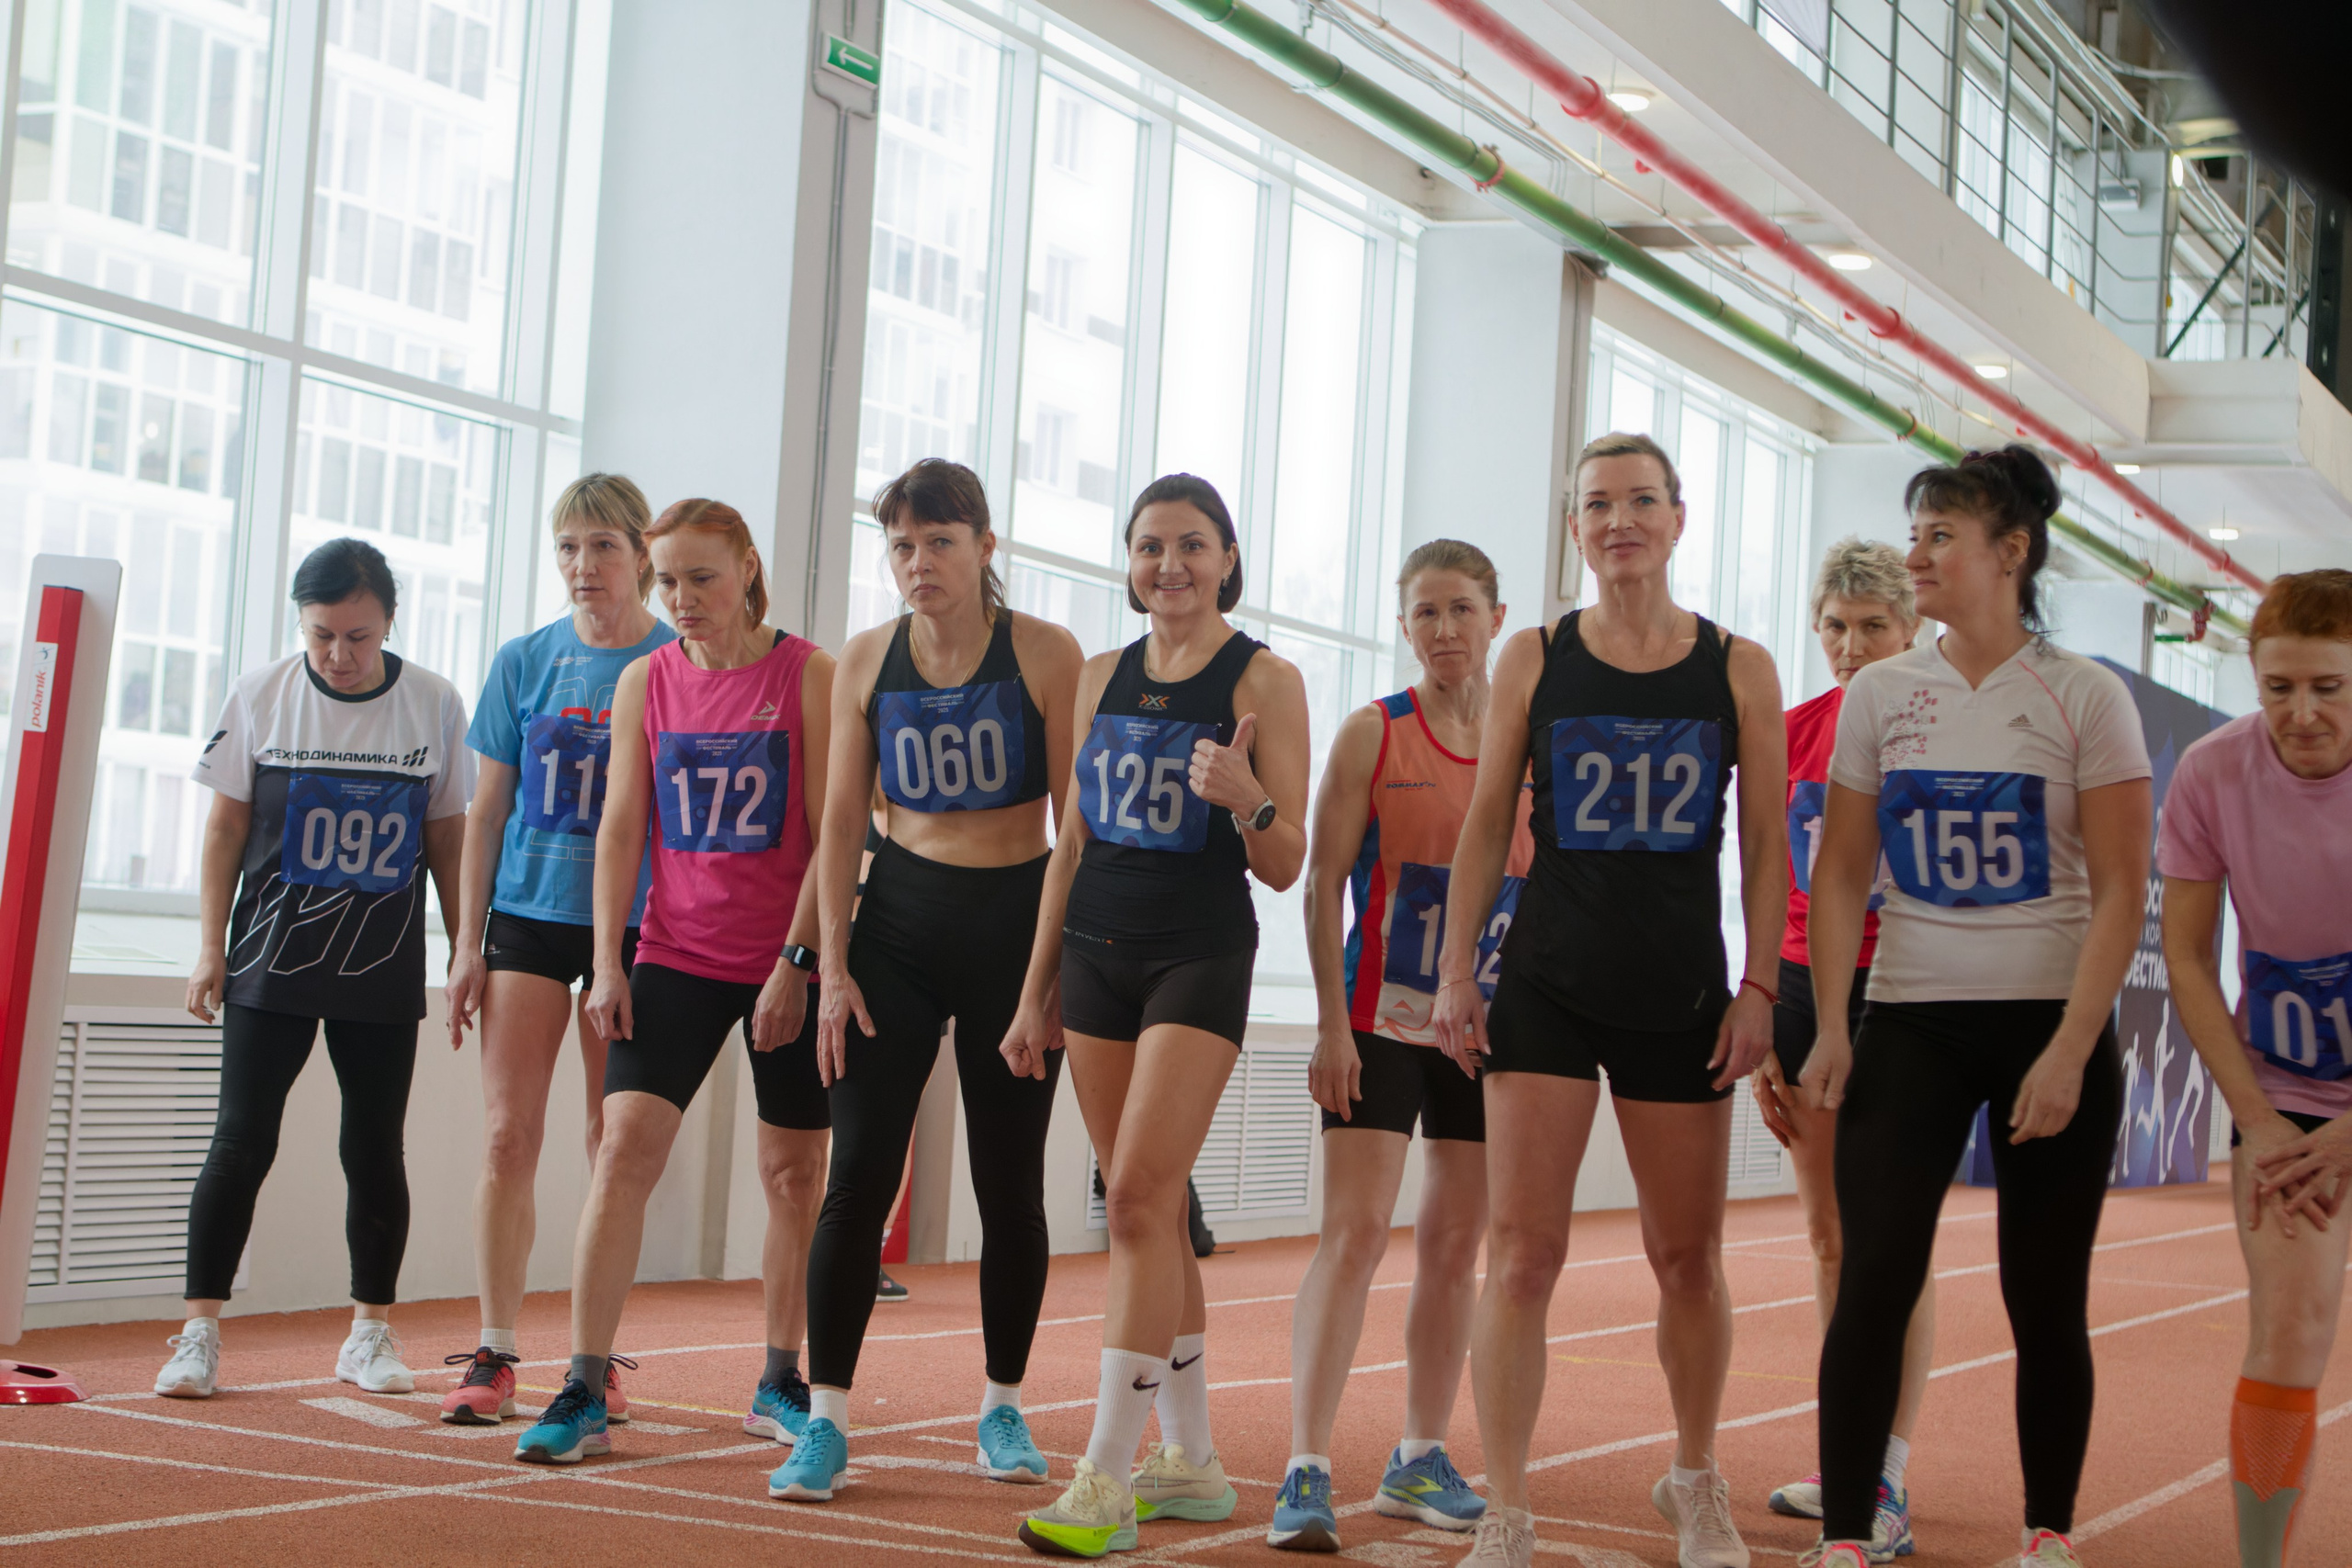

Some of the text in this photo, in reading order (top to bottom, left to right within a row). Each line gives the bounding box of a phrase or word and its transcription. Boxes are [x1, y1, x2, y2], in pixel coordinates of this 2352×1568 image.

[31, 670, 47, 728] polanik
[266, 749, 398, 765] ТЕХНОДИНАМИКА
[540, 749, 610, 820] 11
[895, 718, 1007, 799] 060
[1093, 750, 1186, 834] 125
[1575, 751, 1702, 835] 212
[672, 765, 768, 837] 172
[301, 807, 407, 878] 092
[1902, 808, 2024, 891] 155
